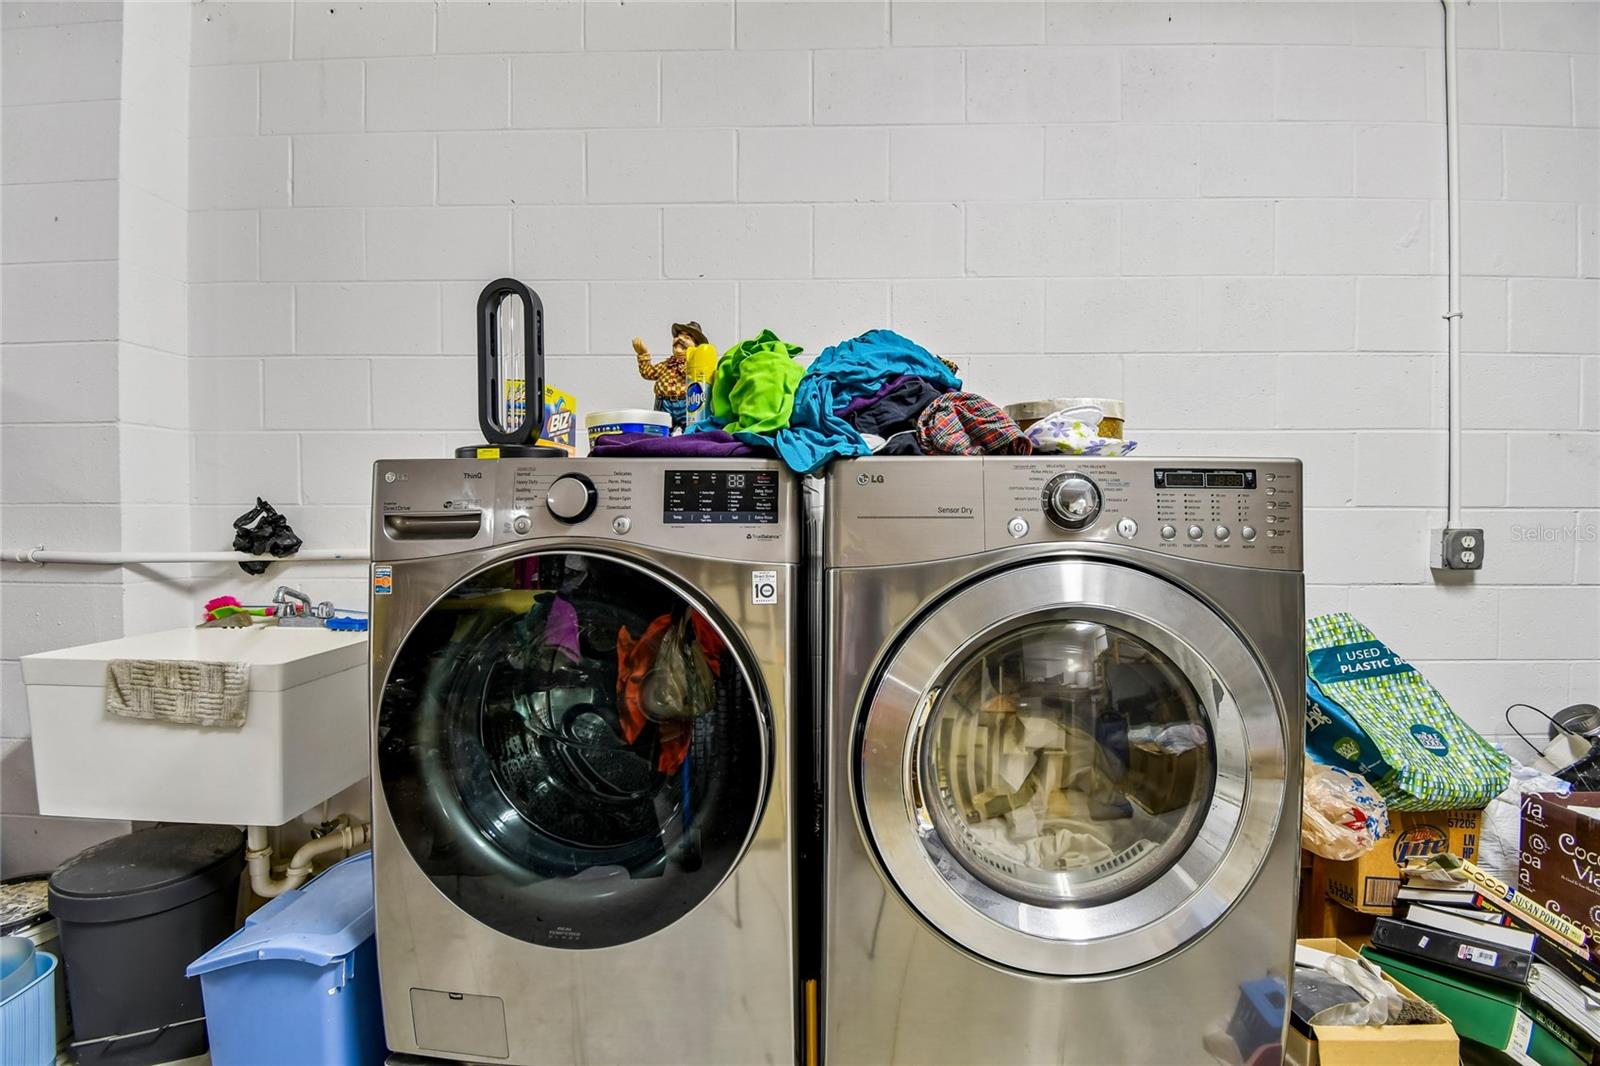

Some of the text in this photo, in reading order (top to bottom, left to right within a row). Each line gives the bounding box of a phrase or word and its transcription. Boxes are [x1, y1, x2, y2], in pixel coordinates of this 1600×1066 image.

[464, 472, 482, 480] ThinQ
[870, 475, 885, 483] LG
[960, 506, 973, 514] Dry
[755, 583, 775, 598] 10
[1336, 653, 1341, 662] I
[1346, 647, 1380, 661] USED
[1340, 658, 1391, 674] PLASTIC
[1448, 817, 1477, 829] 57205
[1463, 834, 1475, 846] LN
[1462, 847, 1474, 859] HP
[1558, 833, 1600, 865] Coc
[1463, 864, 1506, 895] FOOD
[1514, 894, 1571, 936] SUSAN POWTER
